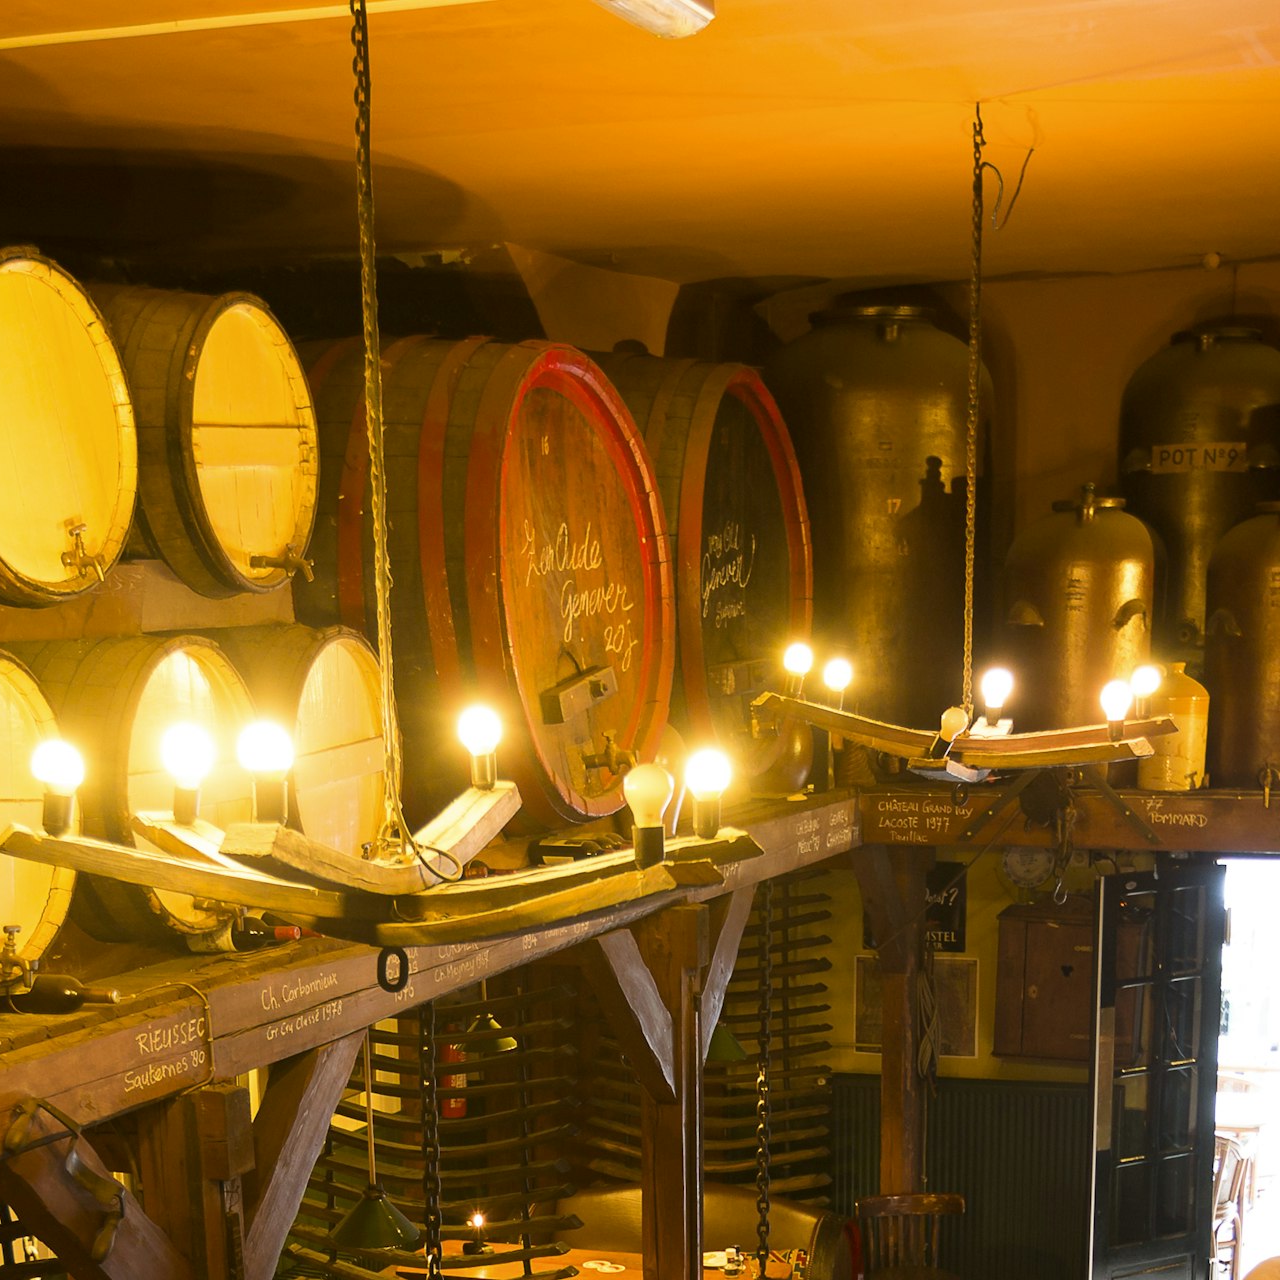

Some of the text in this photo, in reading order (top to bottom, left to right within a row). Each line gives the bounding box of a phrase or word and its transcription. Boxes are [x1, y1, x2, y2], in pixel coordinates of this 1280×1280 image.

[1158, 446, 1198, 466] POT
[560, 578, 634, 643] Genever
[878, 816, 919, 830] LACOSTE
[1150, 812, 1208, 828] POMMARD
[124, 1056, 189, 1092] Sauternes
